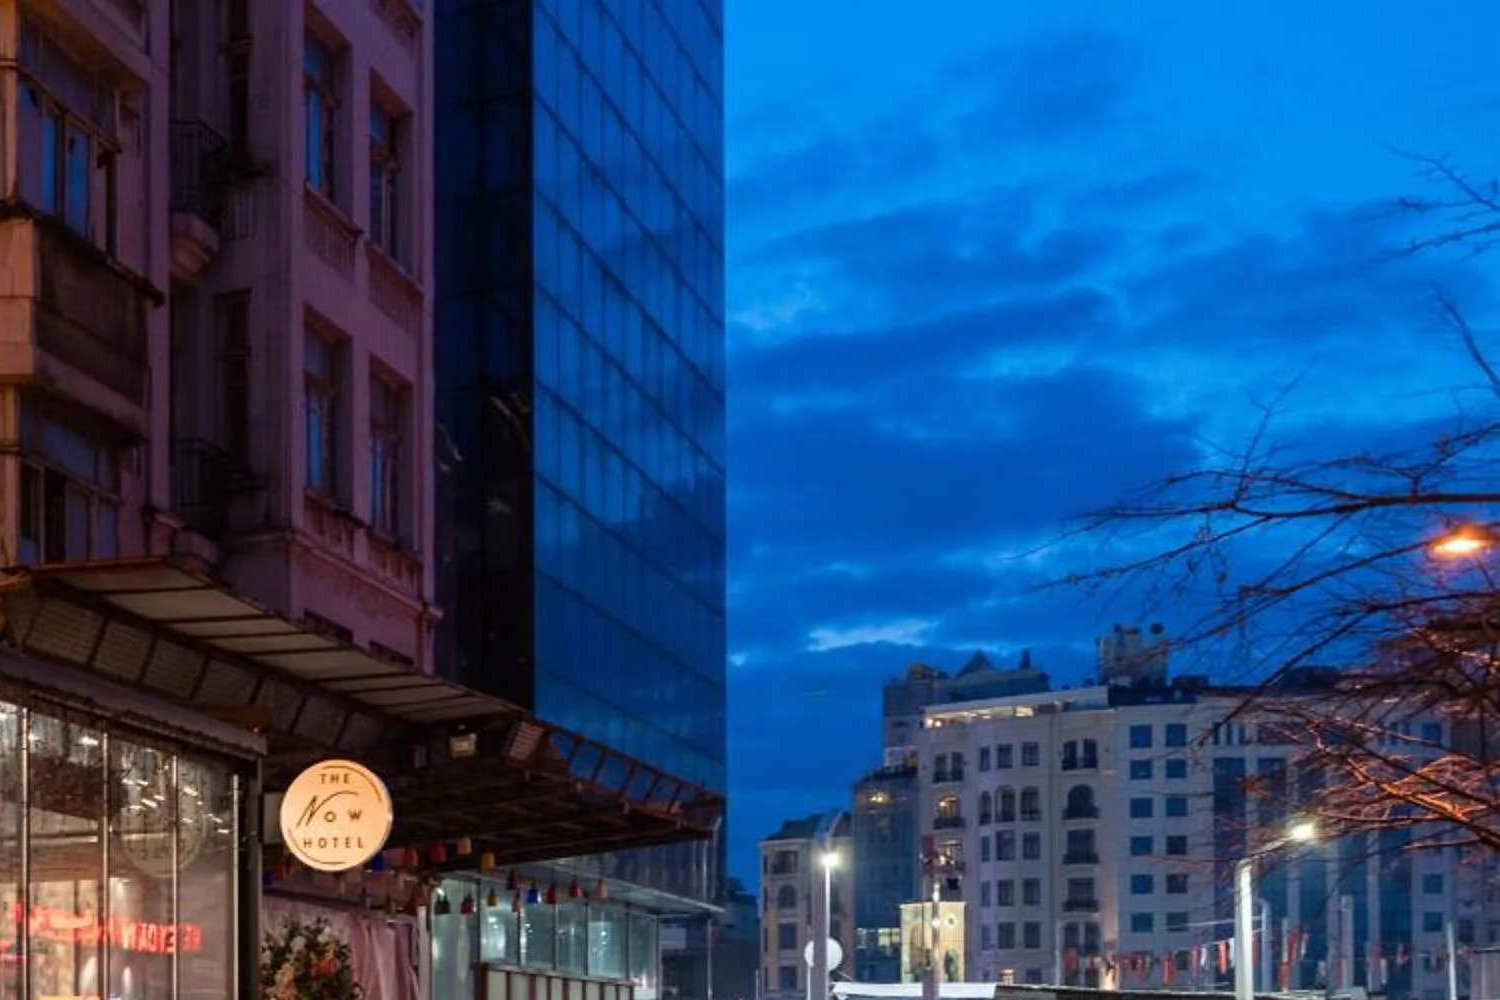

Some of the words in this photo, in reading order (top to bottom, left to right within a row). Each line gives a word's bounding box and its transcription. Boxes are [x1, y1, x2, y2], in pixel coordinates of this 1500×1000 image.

[319, 773, 351, 785] THE
[296, 790, 363, 828] NOW
[303, 837, 364, 849] HOTEL
